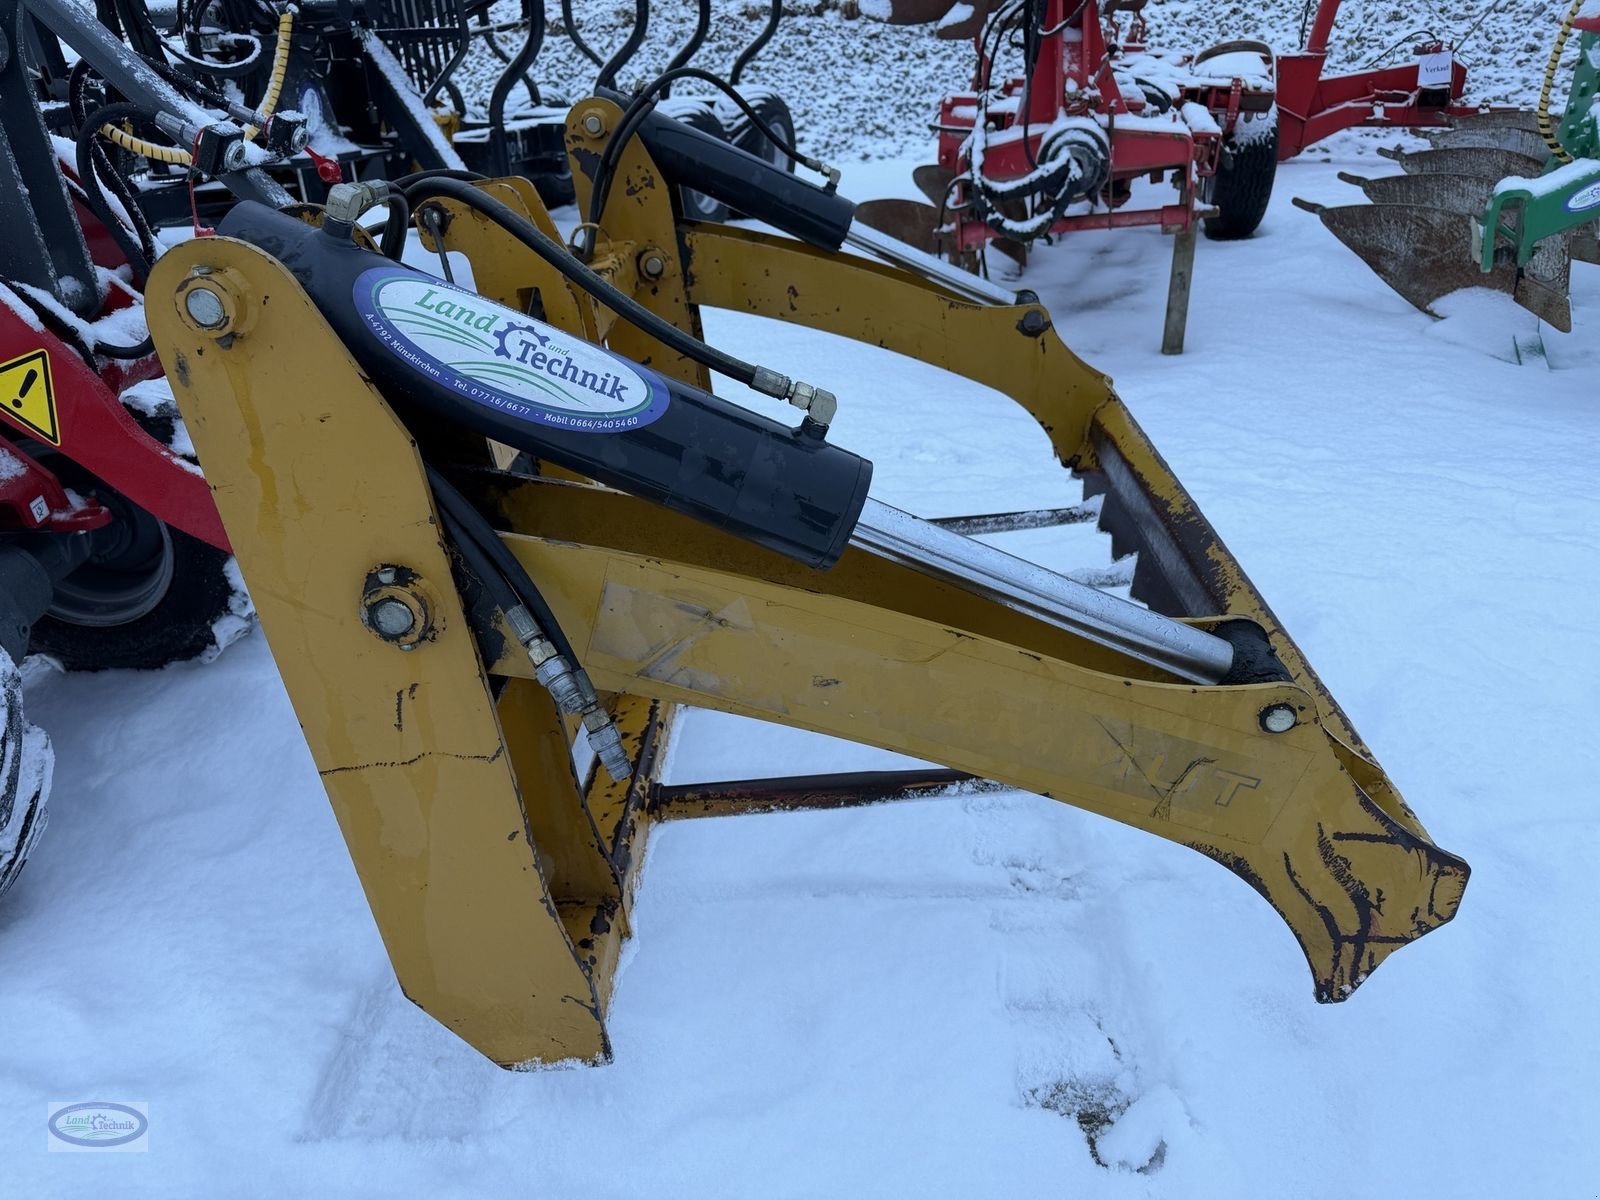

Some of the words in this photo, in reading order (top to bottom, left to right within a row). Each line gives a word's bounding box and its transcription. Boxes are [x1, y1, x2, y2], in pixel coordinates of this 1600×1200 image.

[1425, 64, 1449, 73] Verkauf
[414, 288, 500, 333] Land
[365, 312, 392, 341] A-4792
[390, 339, 440, 377] Münzkirchen
[453, 379, 468, 392] Tel.
[543, 413, 568, 425] Mobil
[516, 338, 629, 403] Technik
[548, 343, 570, 356] und
